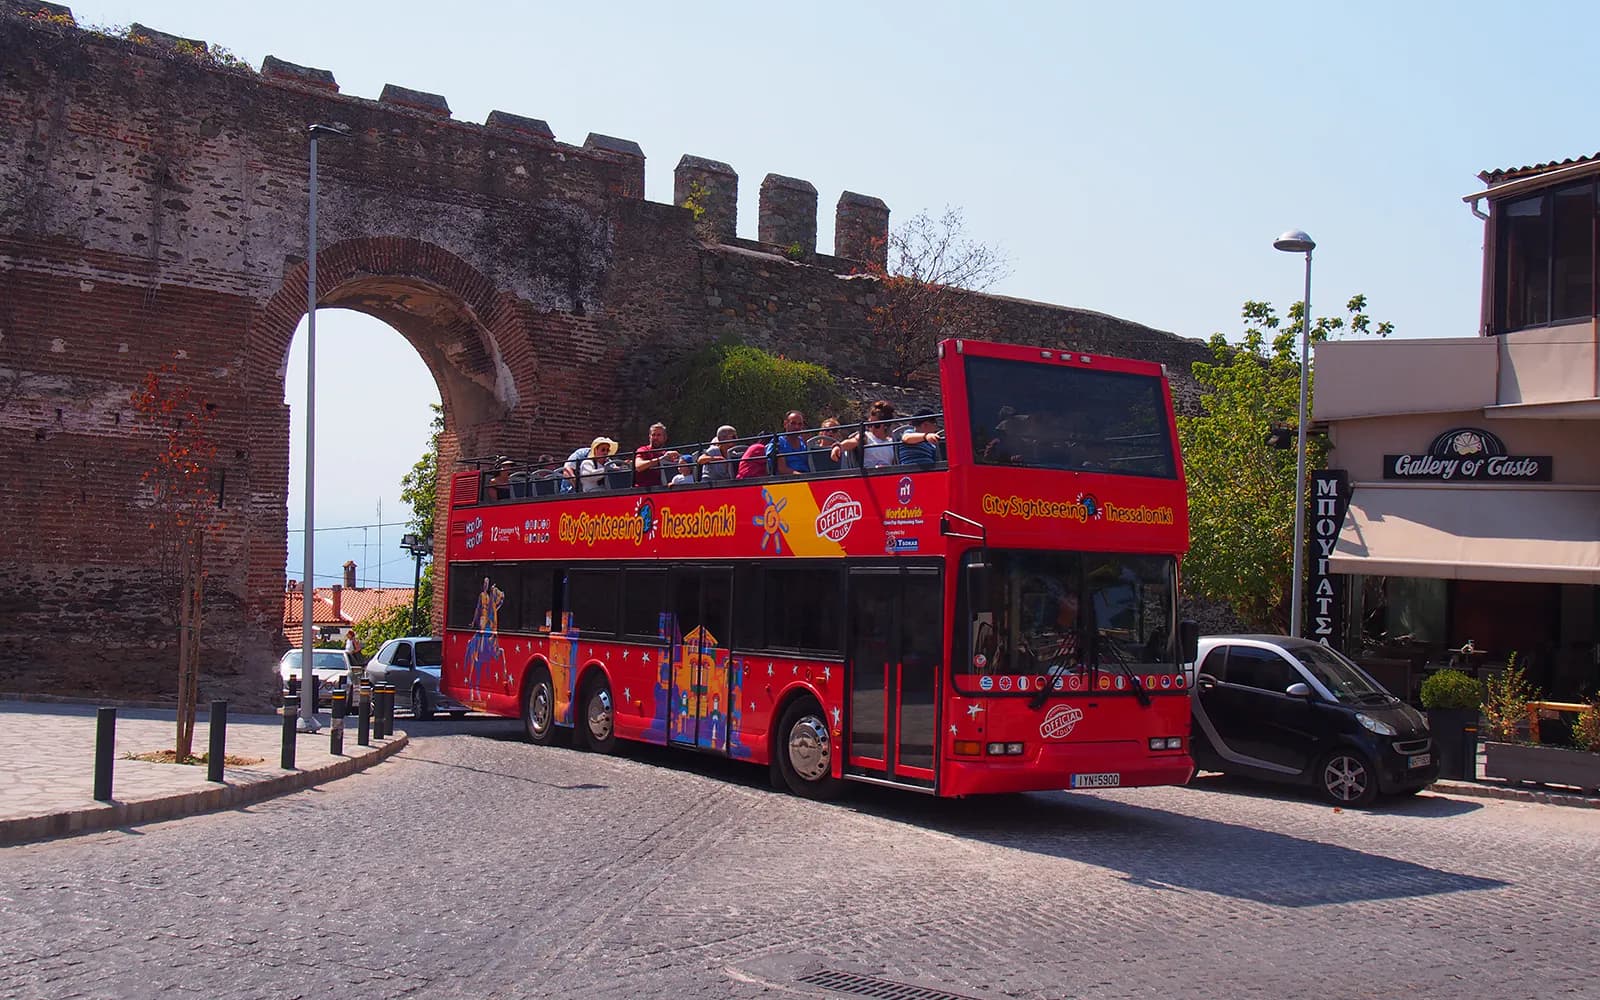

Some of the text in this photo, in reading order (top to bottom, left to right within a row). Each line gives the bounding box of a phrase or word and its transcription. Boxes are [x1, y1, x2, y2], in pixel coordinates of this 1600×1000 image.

[1395, 455, 1538, 479] Gallery of Taste
[661, 504, 736, 538] Thessaloniki
[820, 506, 858, 530] OFFICIAL
[1105, 503, 1174, 525] Thessaloniki
[490, 526, 499, 542] 12
[832, 524, 849, 538] TOUR
[1044, 711, 1080, 733] OFFICIAL
